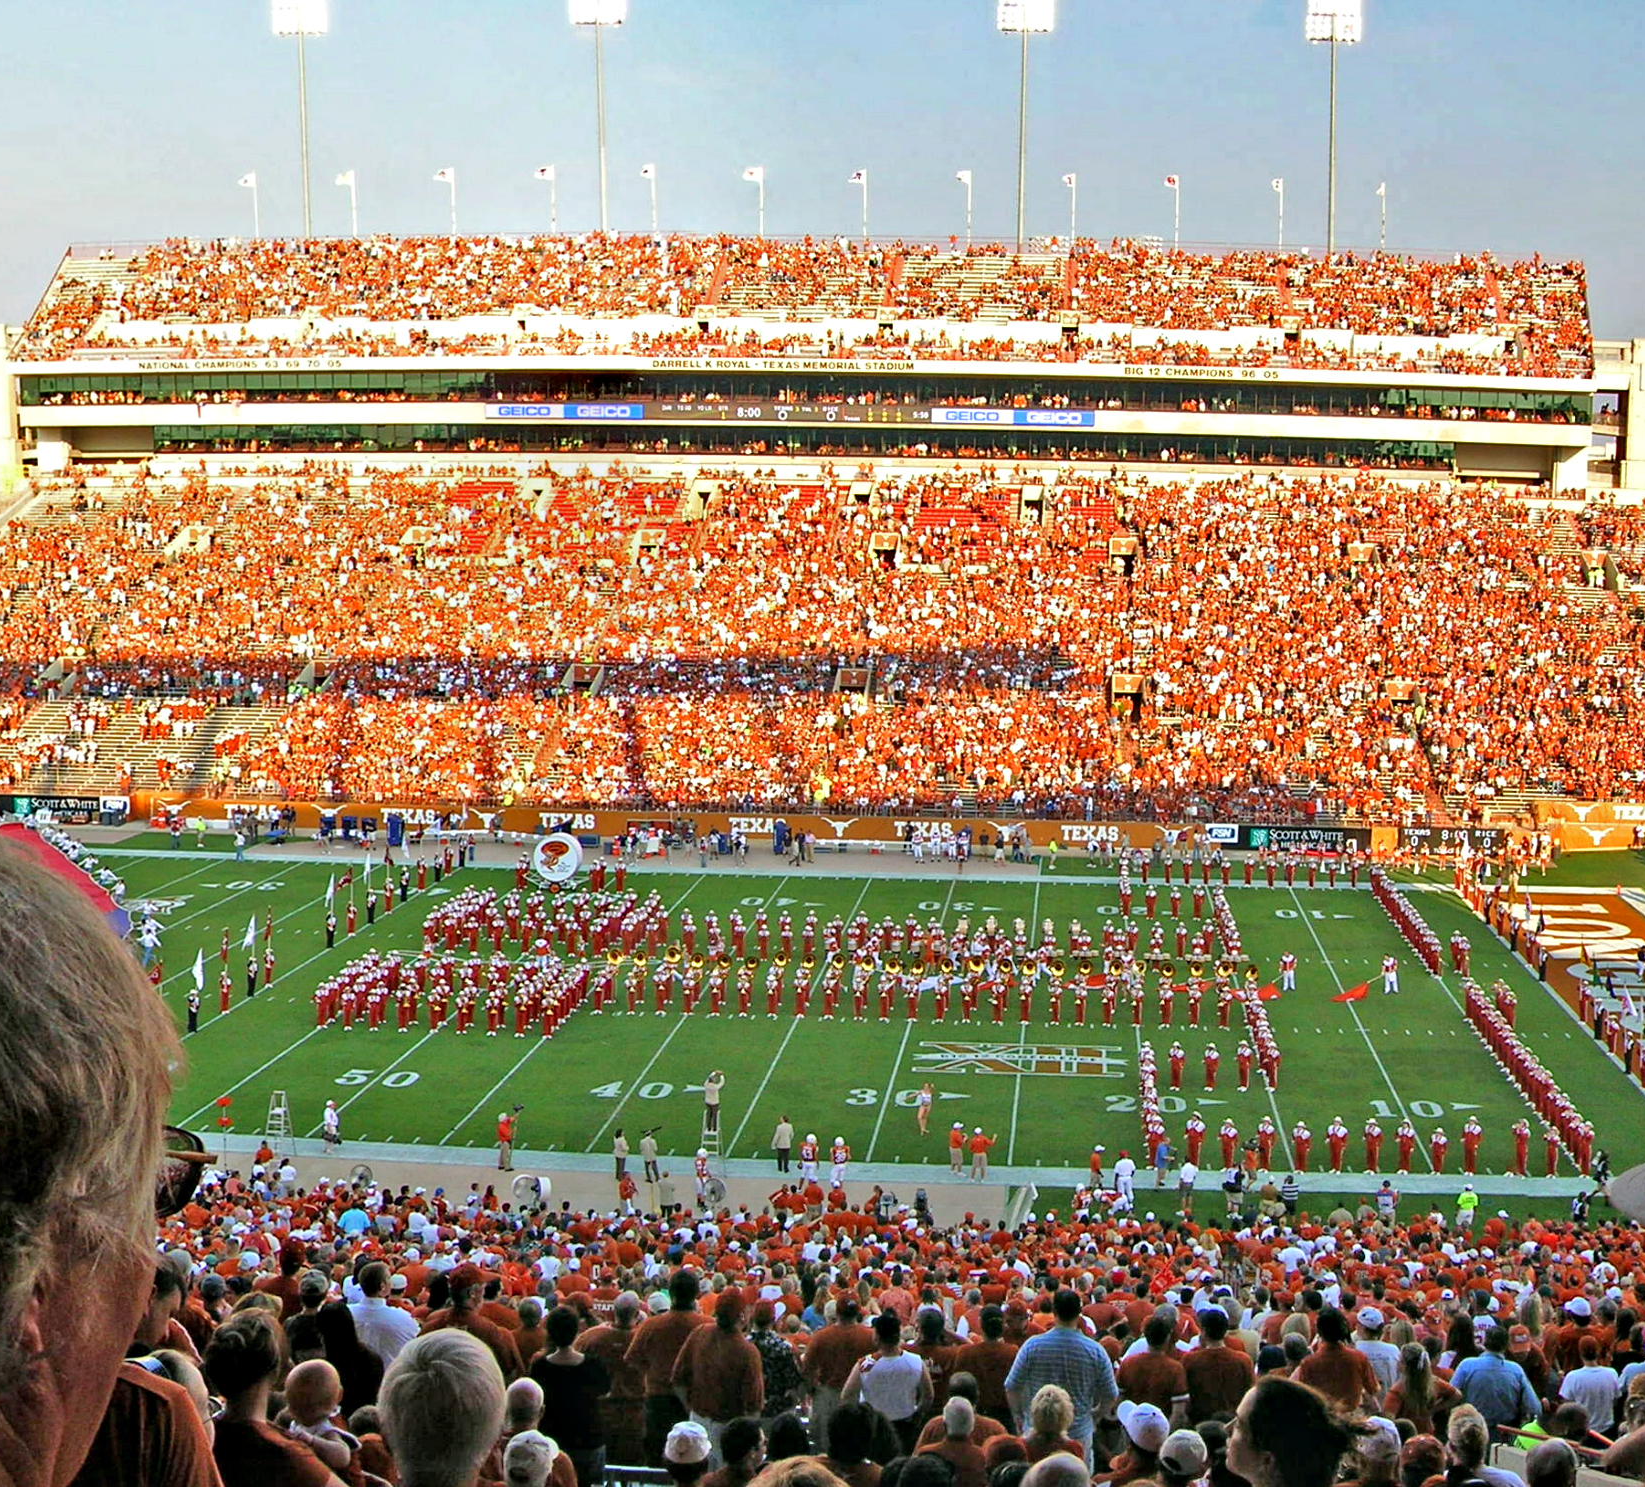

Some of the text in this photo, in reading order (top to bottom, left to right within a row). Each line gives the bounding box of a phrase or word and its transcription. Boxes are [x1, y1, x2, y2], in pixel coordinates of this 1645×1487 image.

[138, 361, 190, 370] NATIONAL
[194, 360, 258, 369] CHAMPIONS
[652, 360, 702, 369] DARRELL
[704, 360, 713, 368] K
[716, 361, 751, 369] ROYAL
[762, 361, 801, 370] TEXAS
[803, 361, 862, 371] MEMORIAL
[865, 362, 915, 371] STADIUM
[1124, 367, 1144, 376] BIG
[1148, 367, 1161, 376] 12
[1165, 367, 1234, 378] CHAMPIONS
[497, 405, 551, 417] GEICO
[576, 405, 631, 418] GEICO
[736, 407, 762, 418] 8:00
[944, 409, 1000, 422] GEICO
[1026, 411, 1083, 425] GEICO
[1060, 824, 1120, 842] TEXAS
[1211, 828, 1233, 838] FSN
[1403, 829, 1431, 837] TEXAS
[1474, 830, 1498, 838] RICE
[1410, 836, 1491, 848] 0 0
[334, 1068, 420, 1088] 50
[590, 1080, 675, 1100] 40
[1104, 1094, 1188, 1114] 20
[1369, 1099, 1445, 1119] 10
